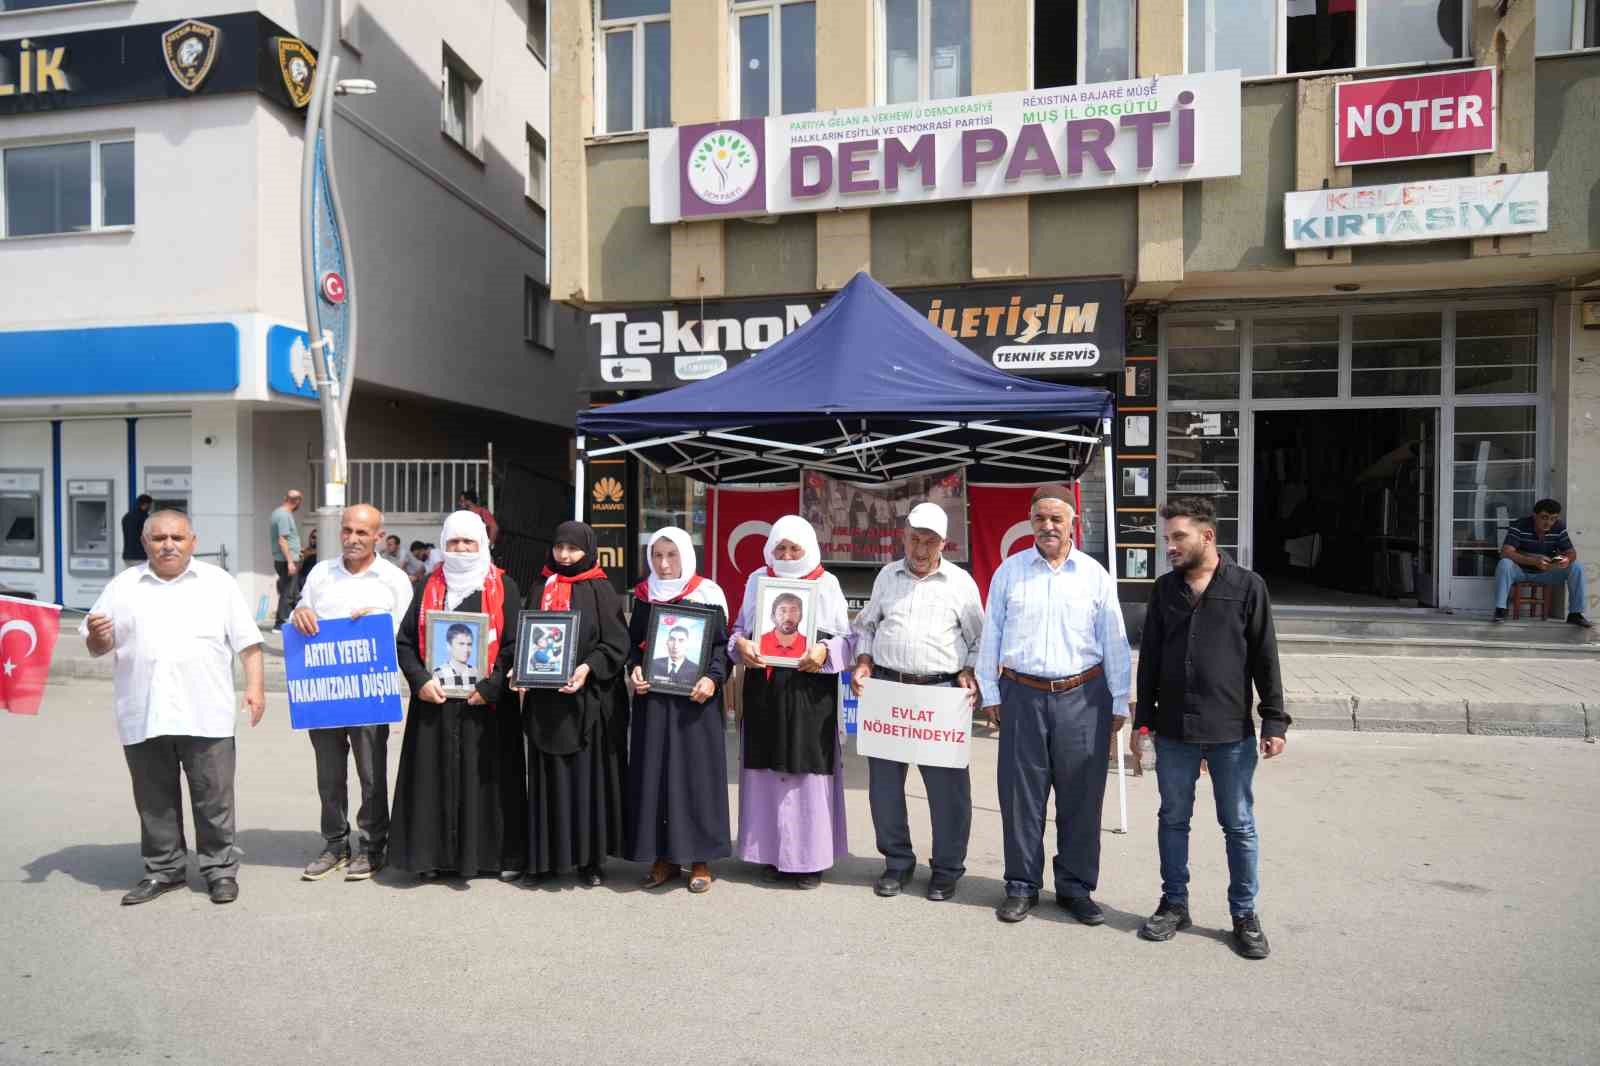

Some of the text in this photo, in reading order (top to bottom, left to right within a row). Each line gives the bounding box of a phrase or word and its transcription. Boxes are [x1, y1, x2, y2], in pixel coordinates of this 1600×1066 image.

[1023, 98, 1158, 124] MUŞ İL ÖRGÜTÜ
[1346, 95, 1484, 138] NOTER
[883, 127, 897, 135] VE
[789, 91, 1196, 199] DEM PARTİ
[1292, 199, 1539, 241] KIRTASİYE
[928, 294, 1099, 343] İLETİŞİM
[997, 348, 1096, 362] TEKNİK SERVİS
[592, 503, 624, 511] HUAWEI
[305, 642, 337, 668] ARTIK
[337, 639, 371, 664] YETER
[288, 666, 400, 703] YAKAMIZDAN DÜŞÜN
[891, 707, 935, 722] EVLAT
[863, 720, 966, 743] NÖBETİNDEYİZ
